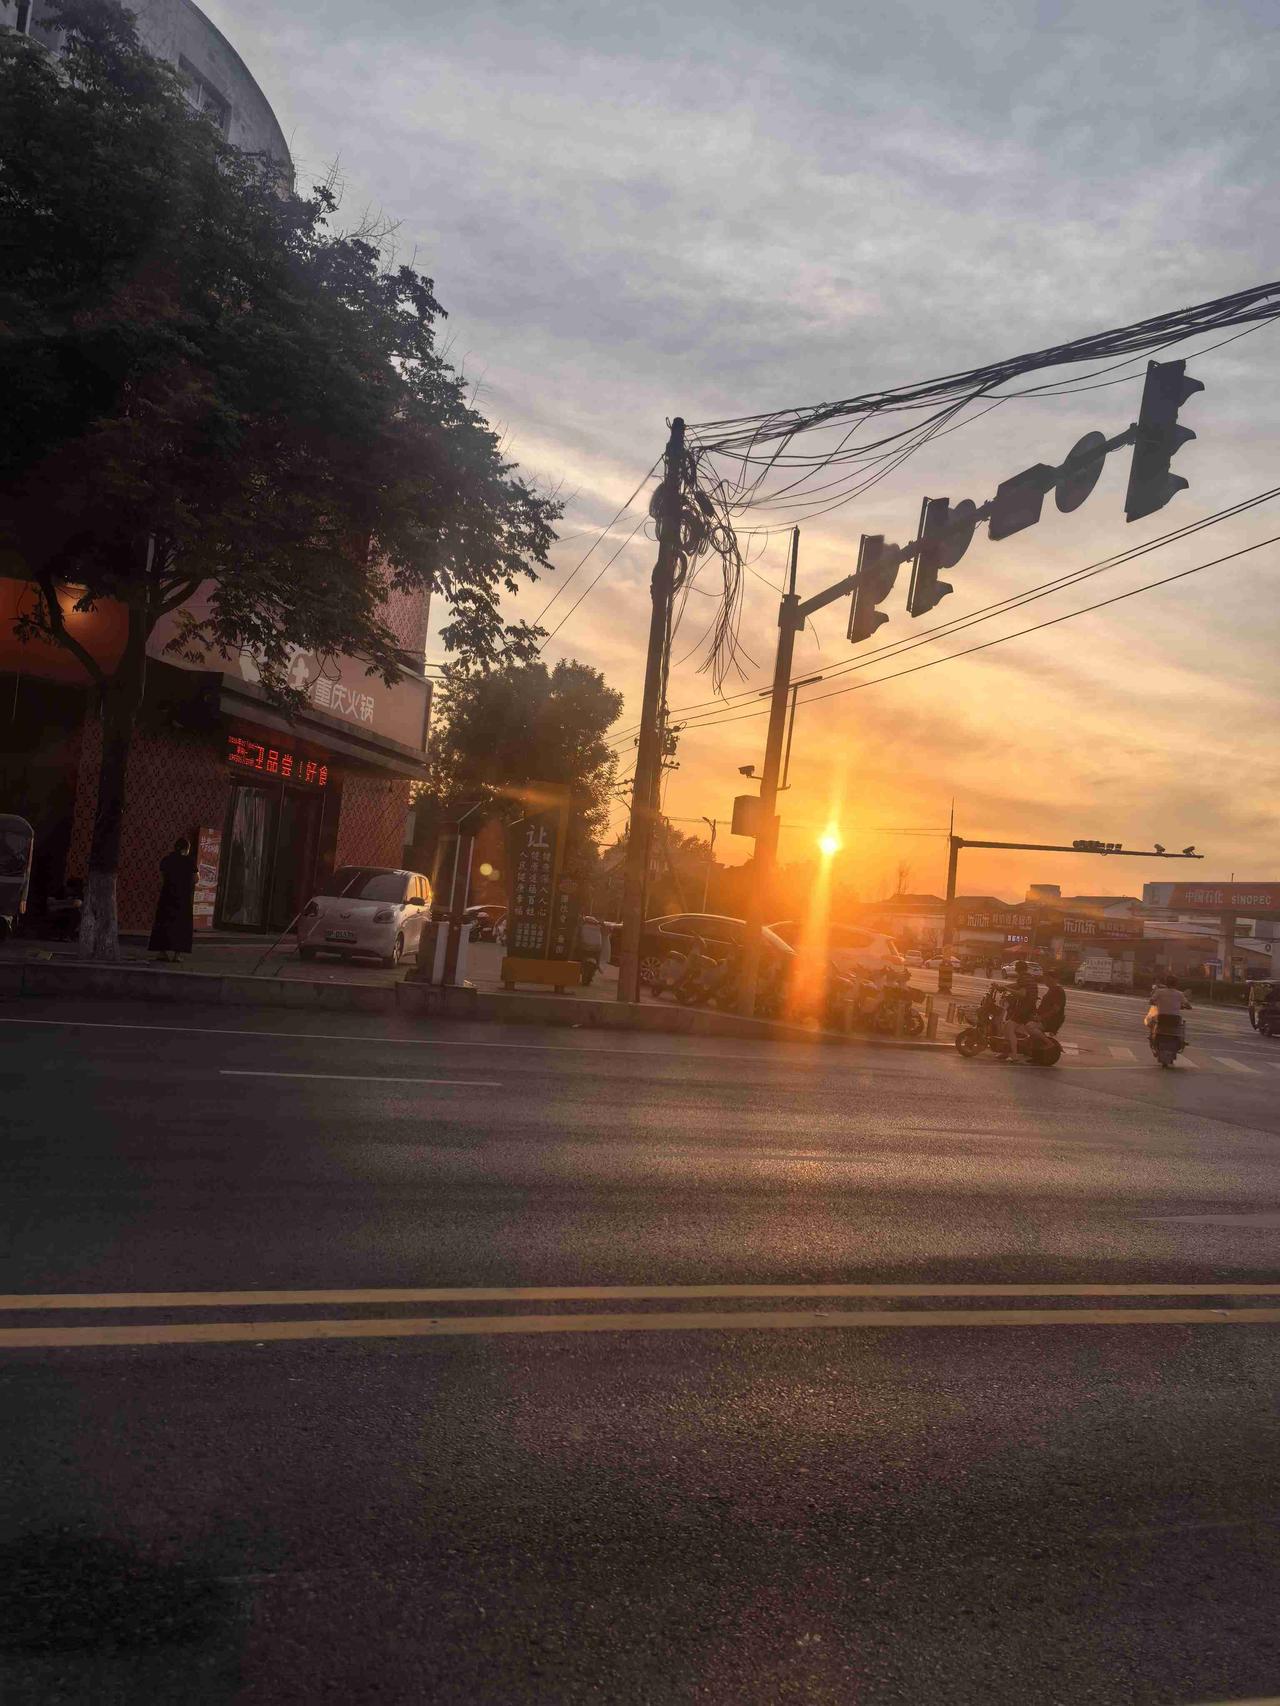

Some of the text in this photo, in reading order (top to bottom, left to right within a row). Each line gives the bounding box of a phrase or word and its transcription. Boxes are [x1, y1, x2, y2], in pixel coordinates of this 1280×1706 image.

[314, 677, 375, 724] 重庆火锅
[526, 824, 549, 848] 让
[1231, 893, 1272, 905] SINOPEC
